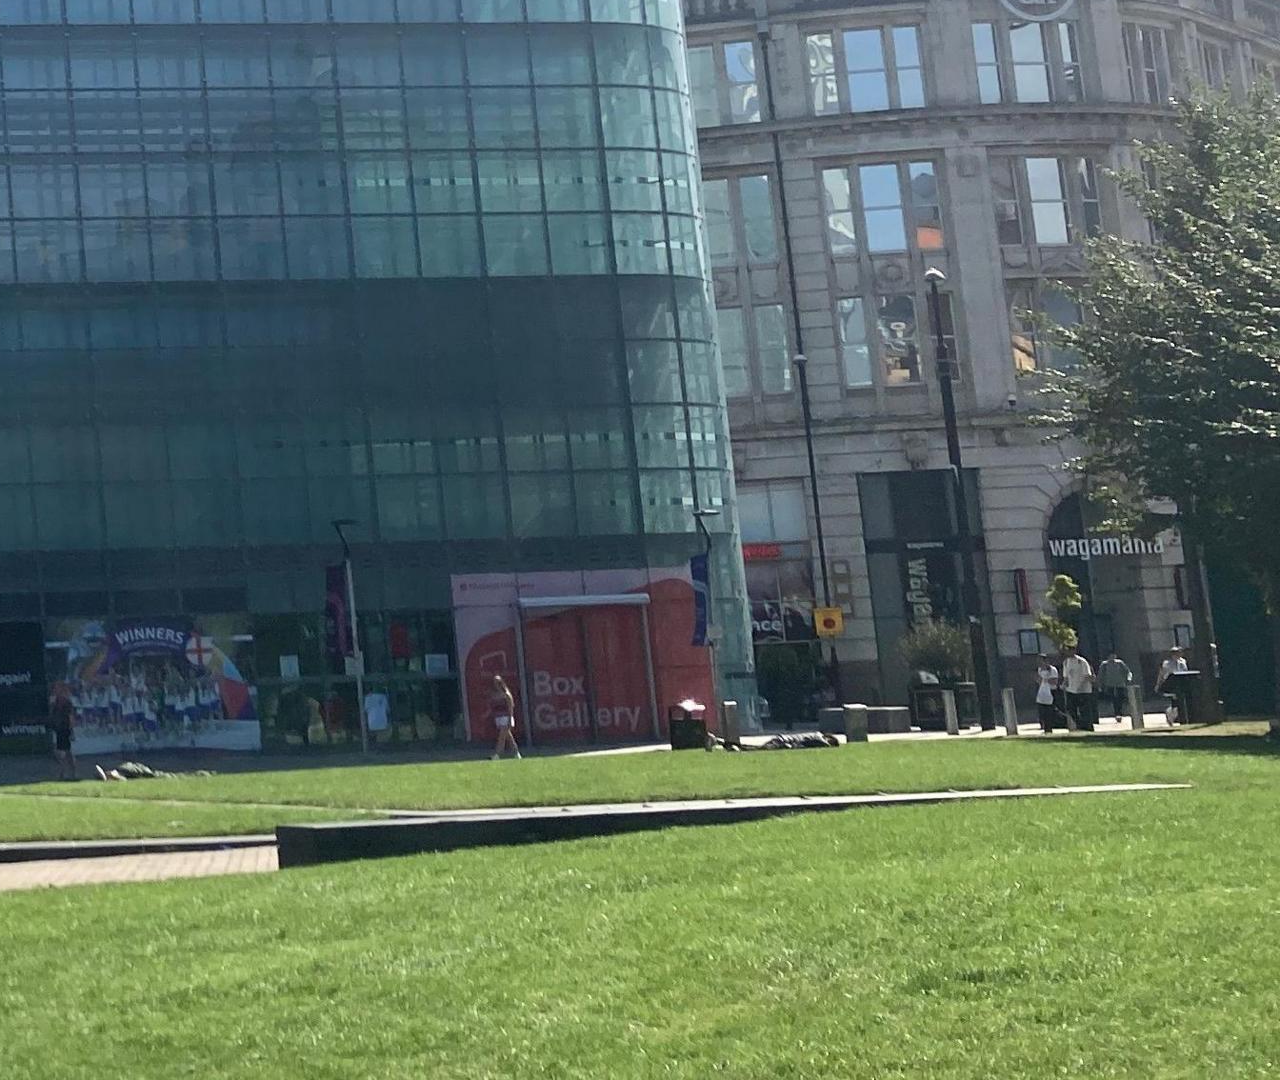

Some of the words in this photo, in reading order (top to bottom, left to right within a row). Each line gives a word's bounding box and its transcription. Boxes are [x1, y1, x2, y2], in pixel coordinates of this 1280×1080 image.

[115, 627, 184, 645] WINNERS
[533, 670, 585, 696] Box
[2, 722, 46, 735] winners
[533, 702, 641, 733] Gallery
